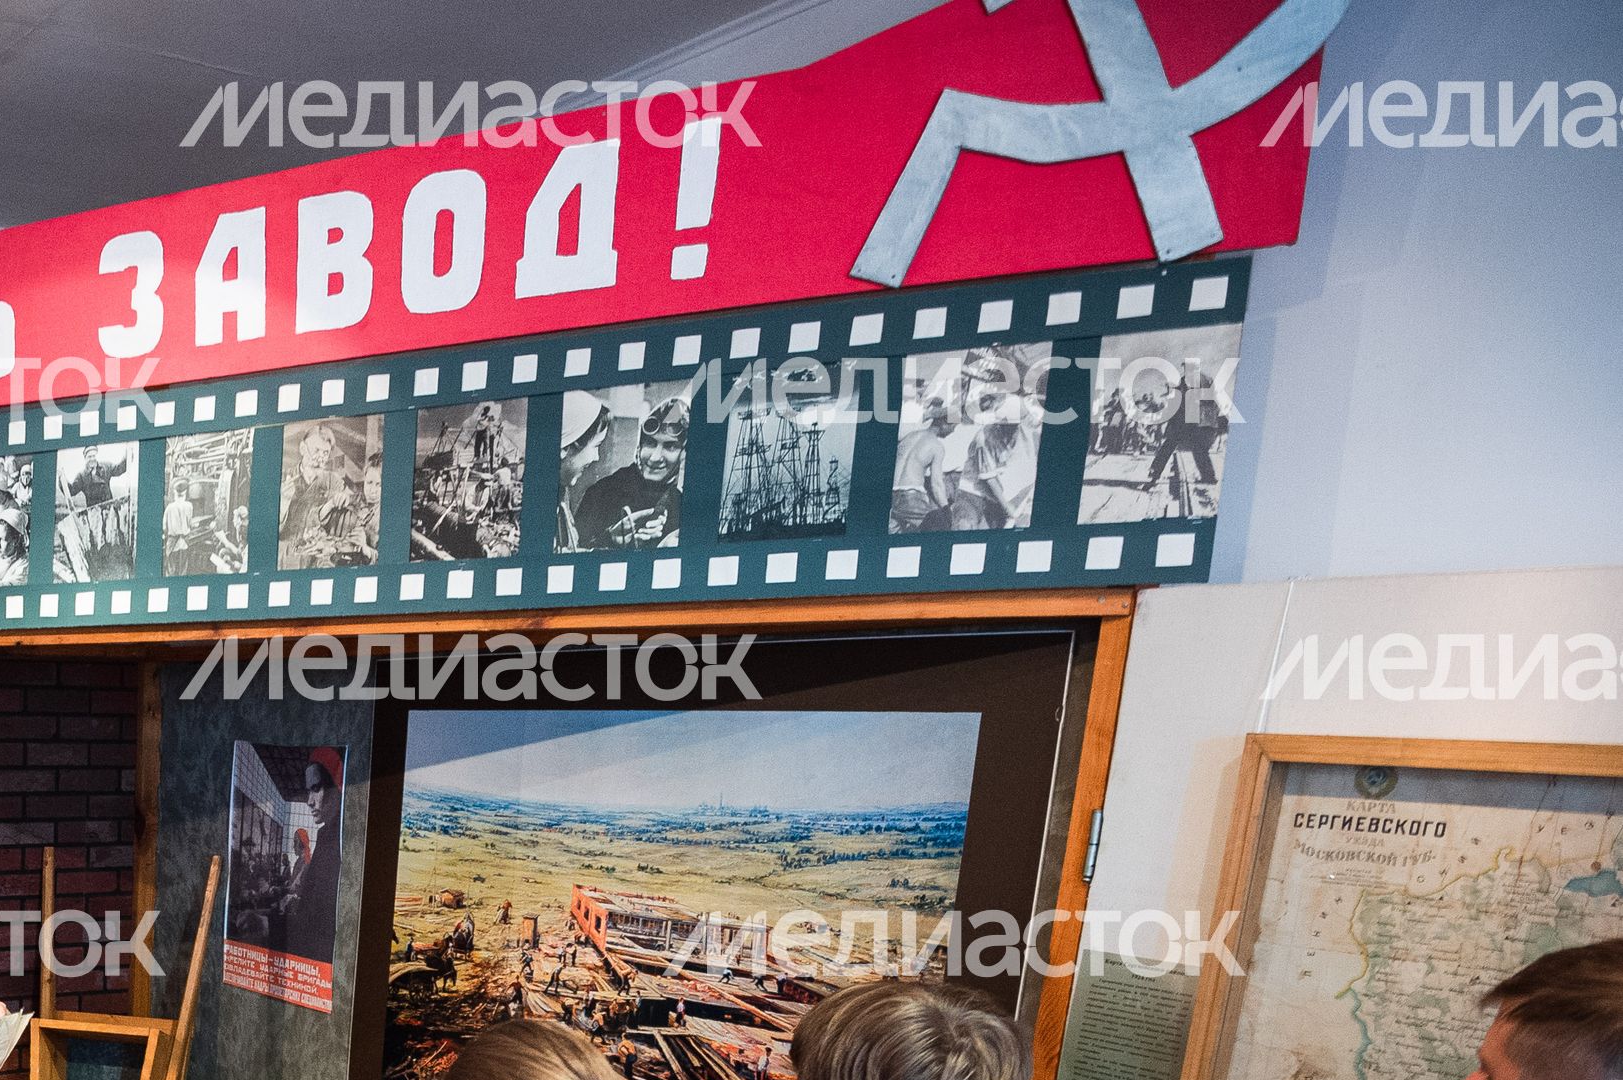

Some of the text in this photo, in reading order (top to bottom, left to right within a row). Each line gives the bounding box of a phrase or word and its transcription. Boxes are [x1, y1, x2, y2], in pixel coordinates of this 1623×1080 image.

[98, 115, 722, 359] ЗАВОД!
[1346, 800, 1397, 814] КАРТА
[1293, 812, 1448, 839] СЕРГИЕВСКОГО
